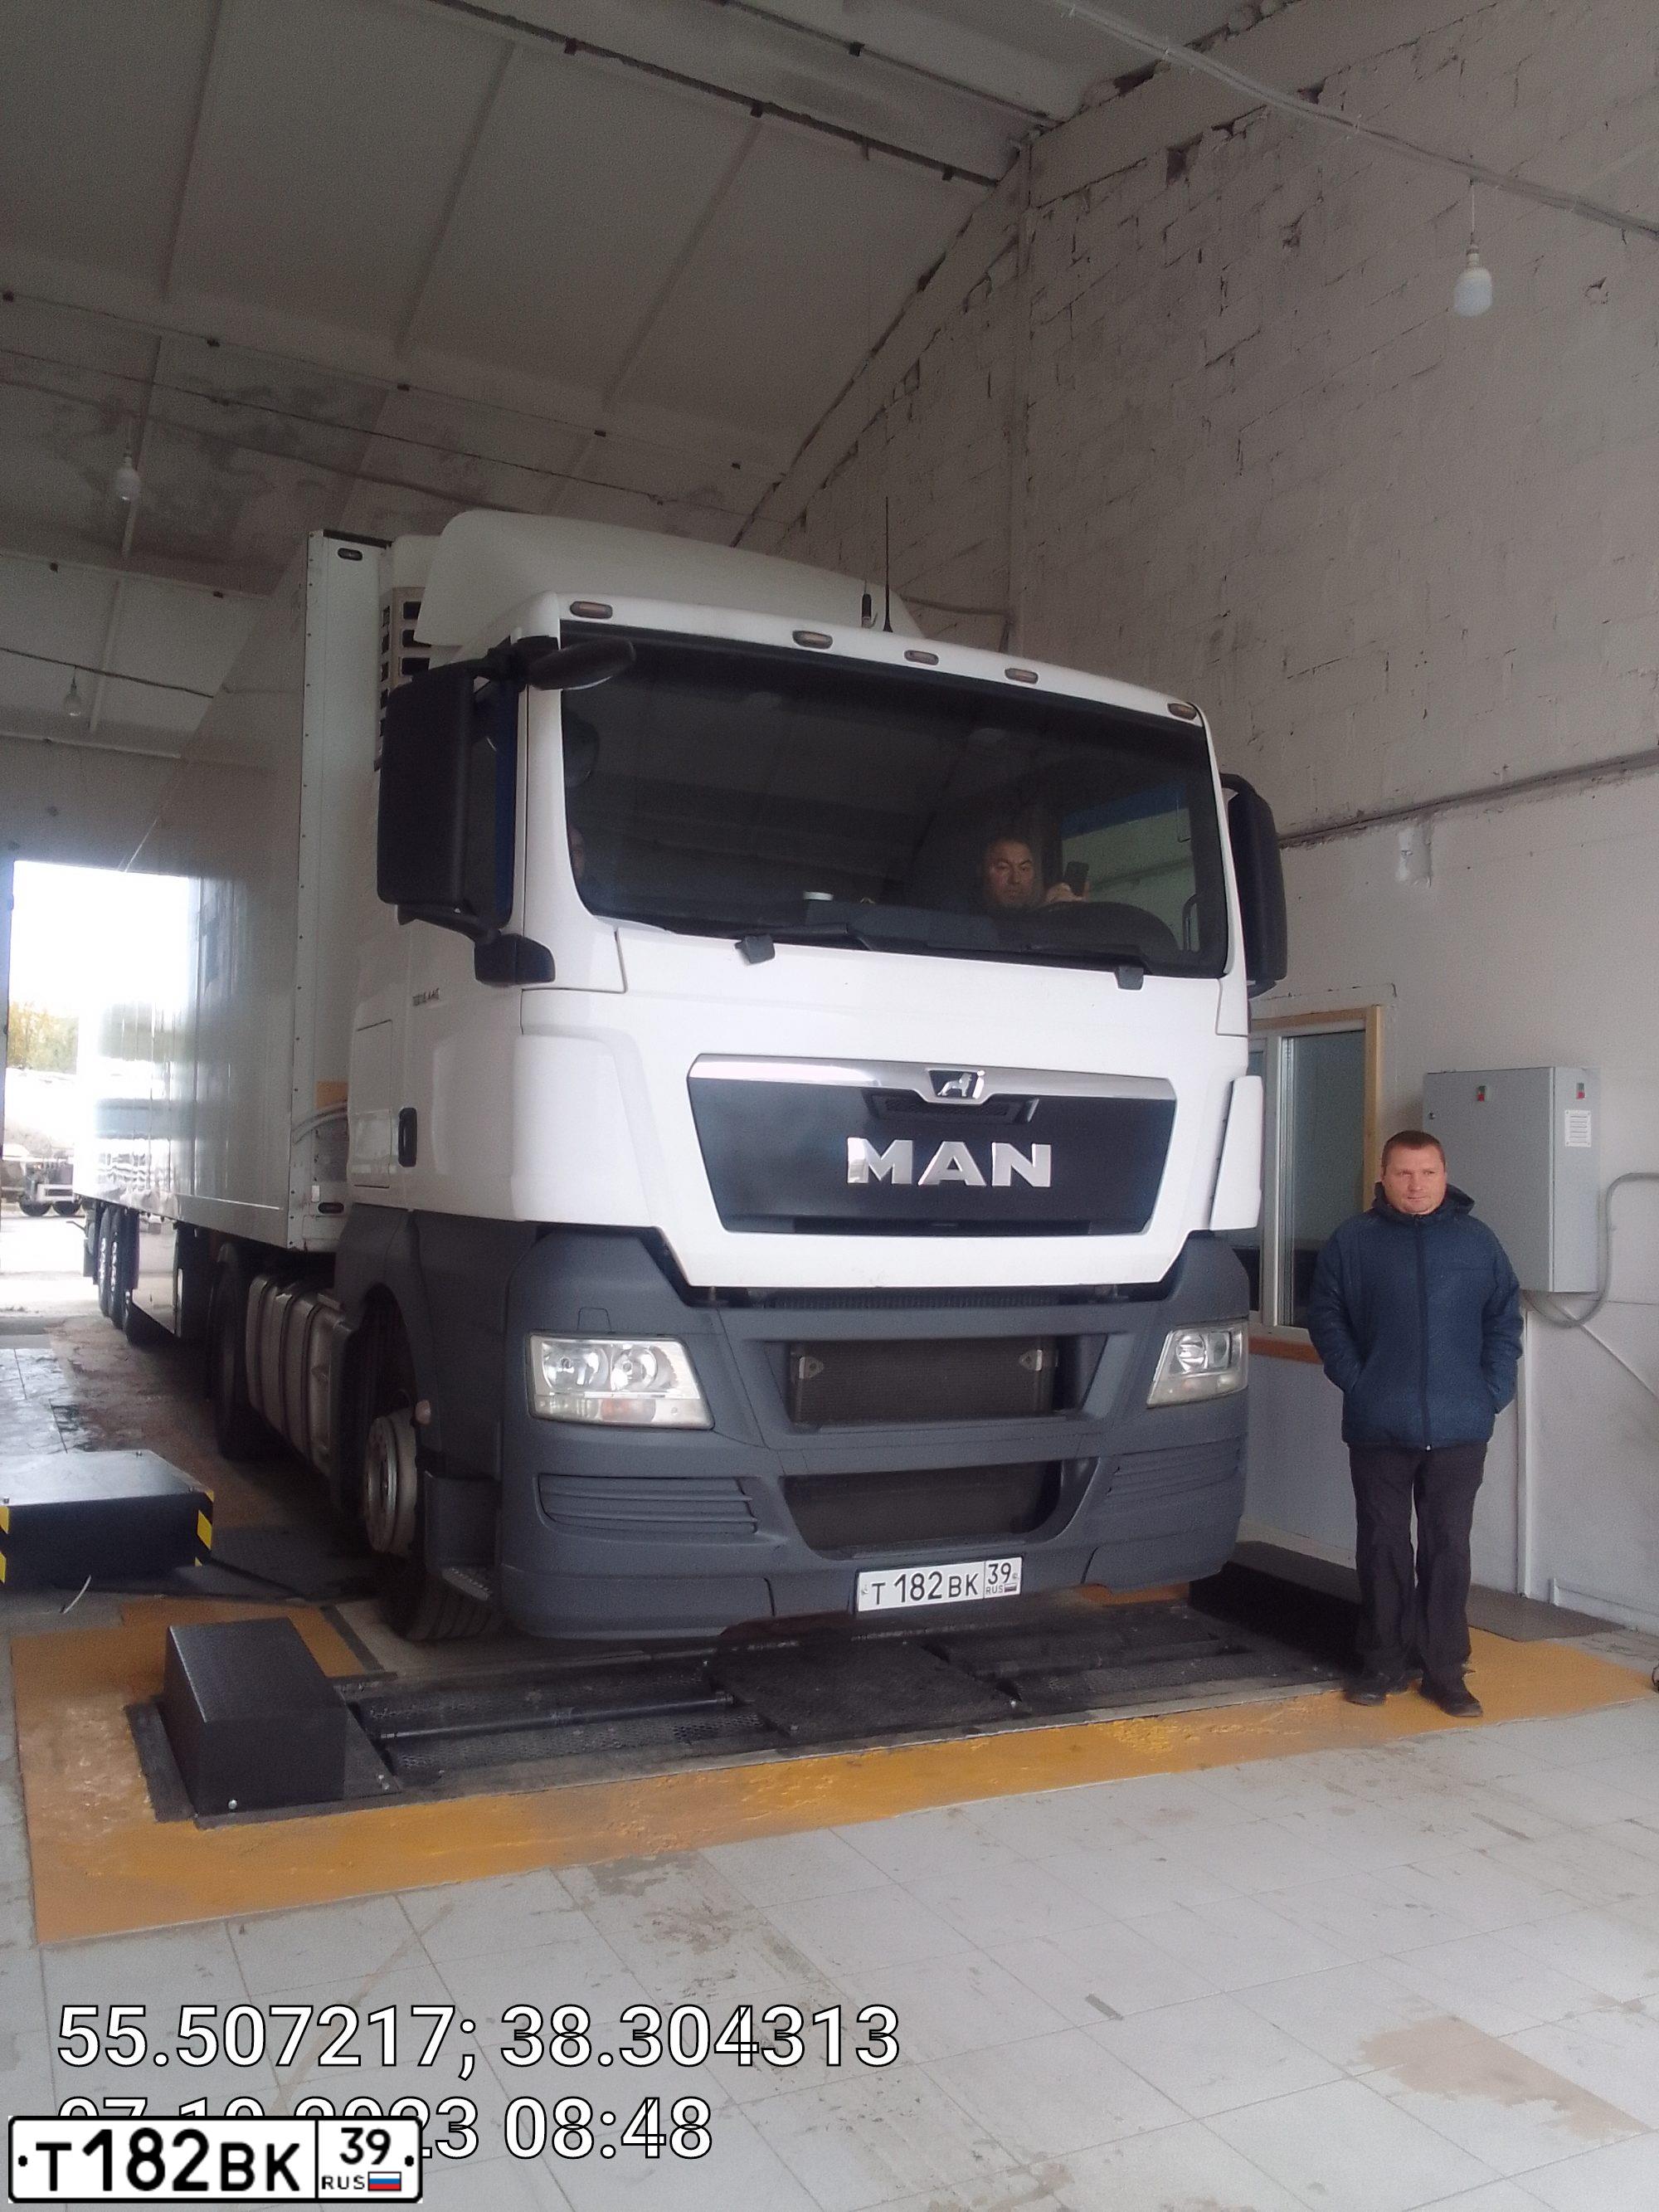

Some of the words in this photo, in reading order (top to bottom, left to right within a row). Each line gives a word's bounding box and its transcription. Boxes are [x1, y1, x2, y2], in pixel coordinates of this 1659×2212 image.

[847, 1137, 1052, 1187] MAN
[987, 1562, 1012, 1585] 39
[985, 1585, 1004, 1594] RUS
